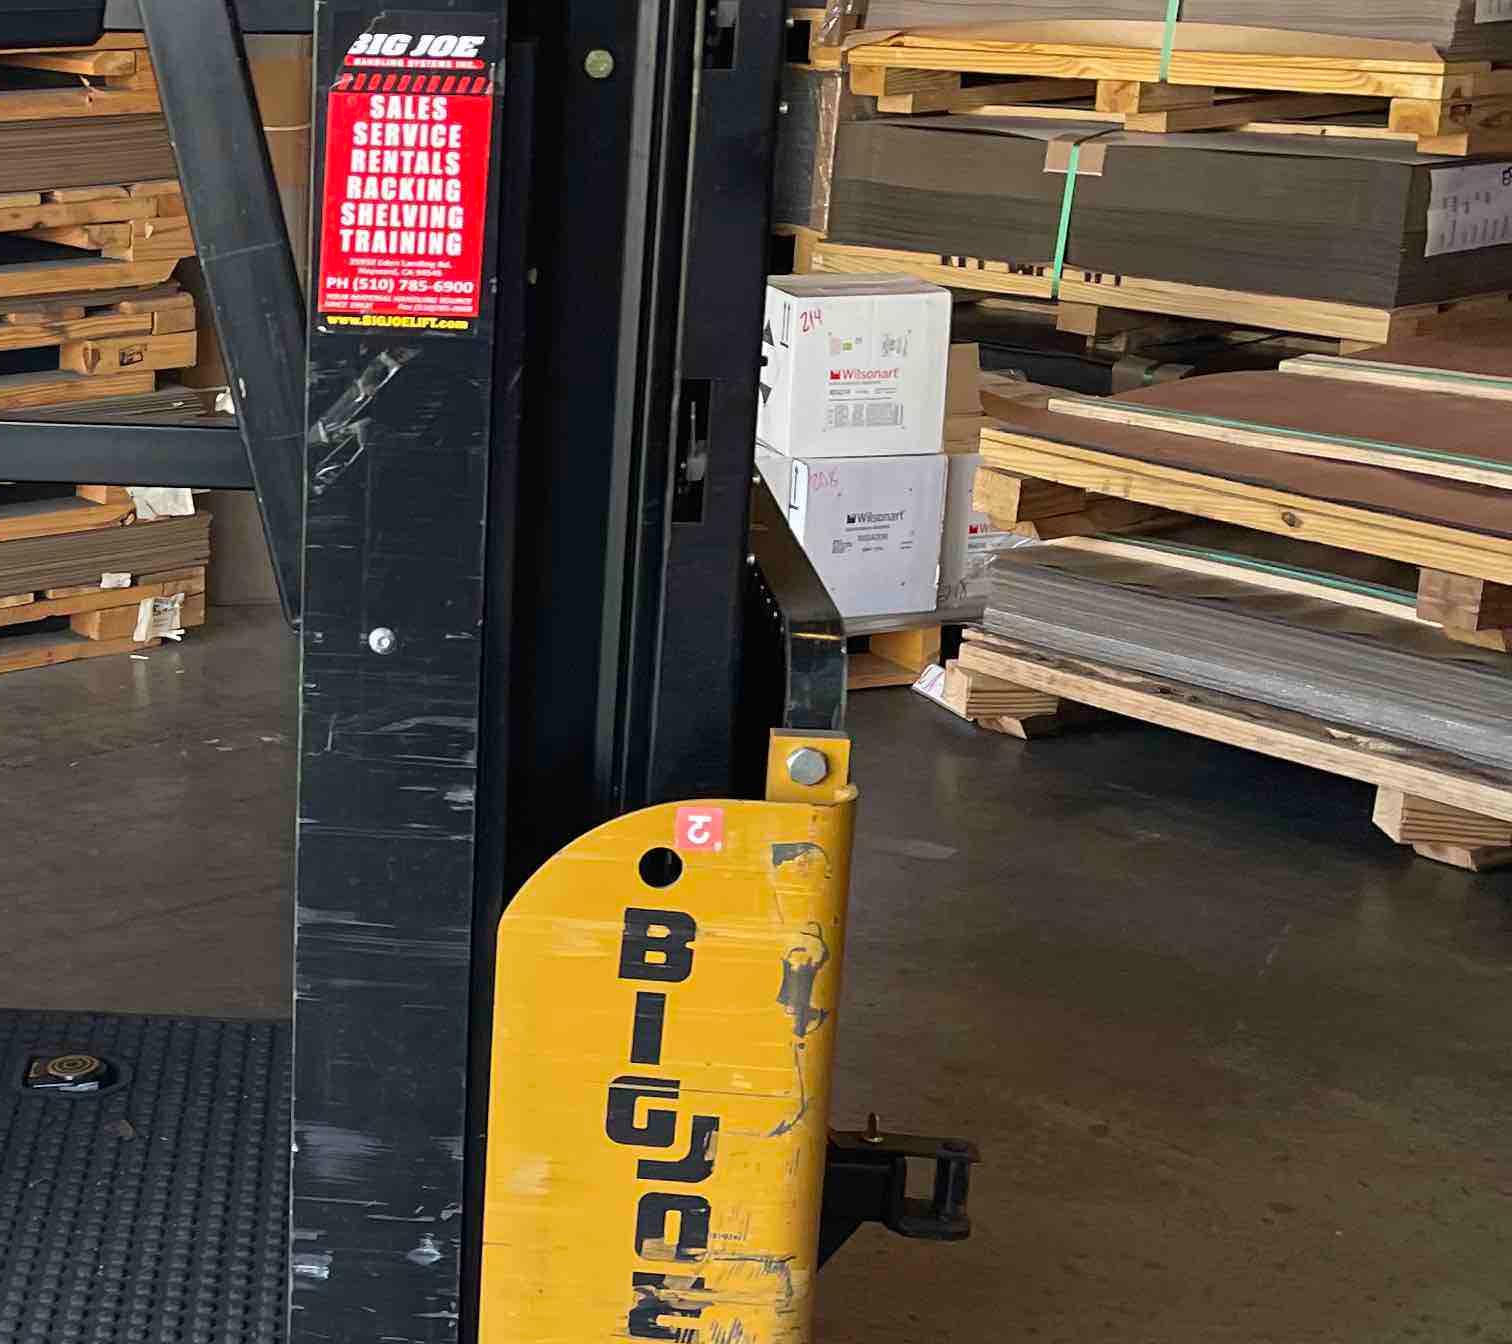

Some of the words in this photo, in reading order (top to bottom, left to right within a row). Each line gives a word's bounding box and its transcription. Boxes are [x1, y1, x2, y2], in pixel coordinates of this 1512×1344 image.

[347, 33, 413, 56] BIG
[409, 34, 486, 58] JOE
[369, 94, 448, 121] SALES
[352, 121, 462, 148] SERVICE
[350, 148, 461, 176] RENTALS
[346, 175, 461, 202] RACKING
[340, 202, 464, 229] SHELVING
[339, 229, 462, 256] TRAINING
[326, 277, 349, 290] PH
[352, 277, 395, 293] (510)
[399, 279, 474, 293] 785-6900
[800, 308, 823, 333] 214
[842, 368, 900, 380] Wilsonart
[857, 509, 905, 523] Wilsonart
